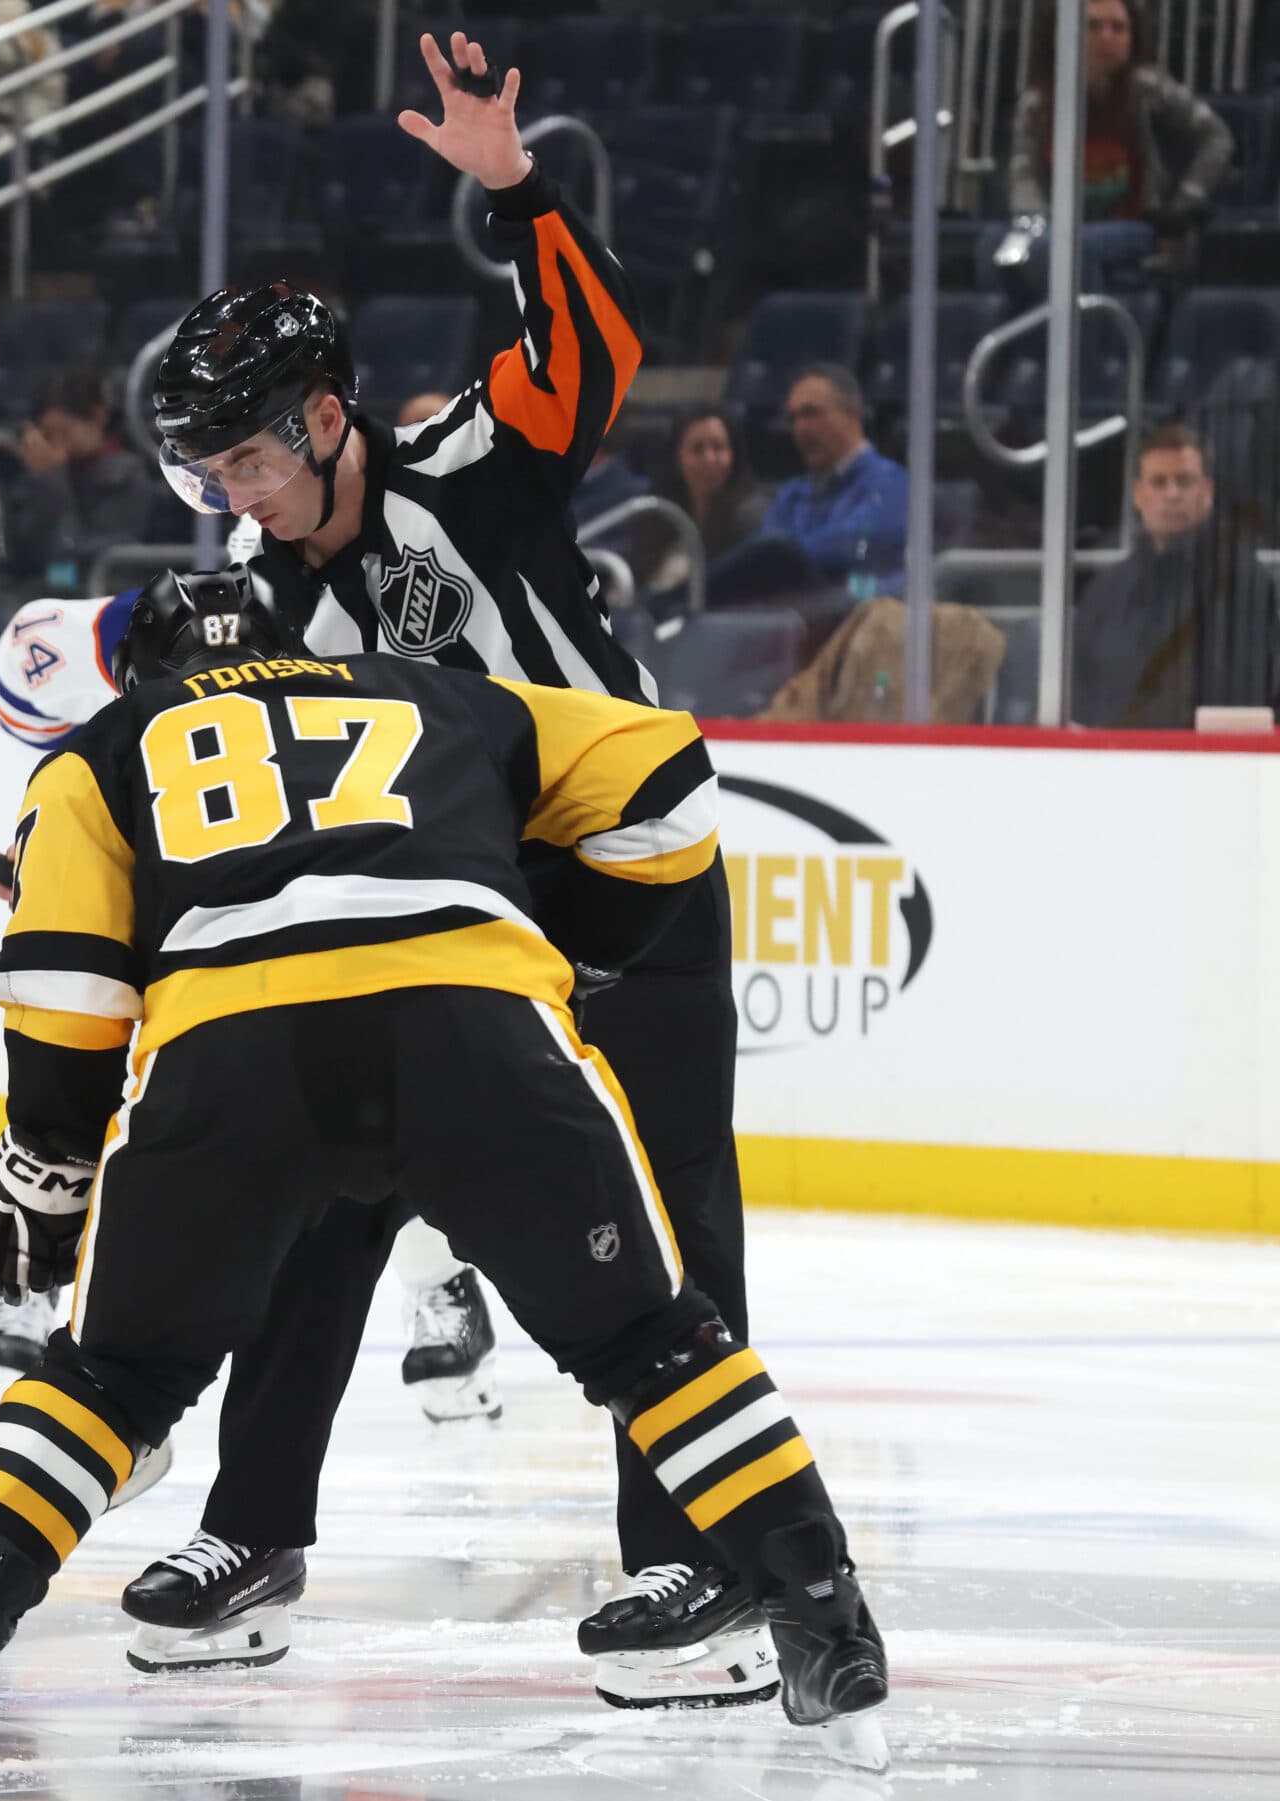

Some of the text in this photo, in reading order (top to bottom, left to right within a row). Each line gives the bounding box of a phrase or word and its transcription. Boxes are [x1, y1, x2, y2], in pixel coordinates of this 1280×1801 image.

[202, 613, 240, 647] 87
[405, 577, 434, 640] NHL
[12, 608, 67, 693] 14
[140, 692, 424, 864] 87
[228, 1576, 269, 1606] BAUER
